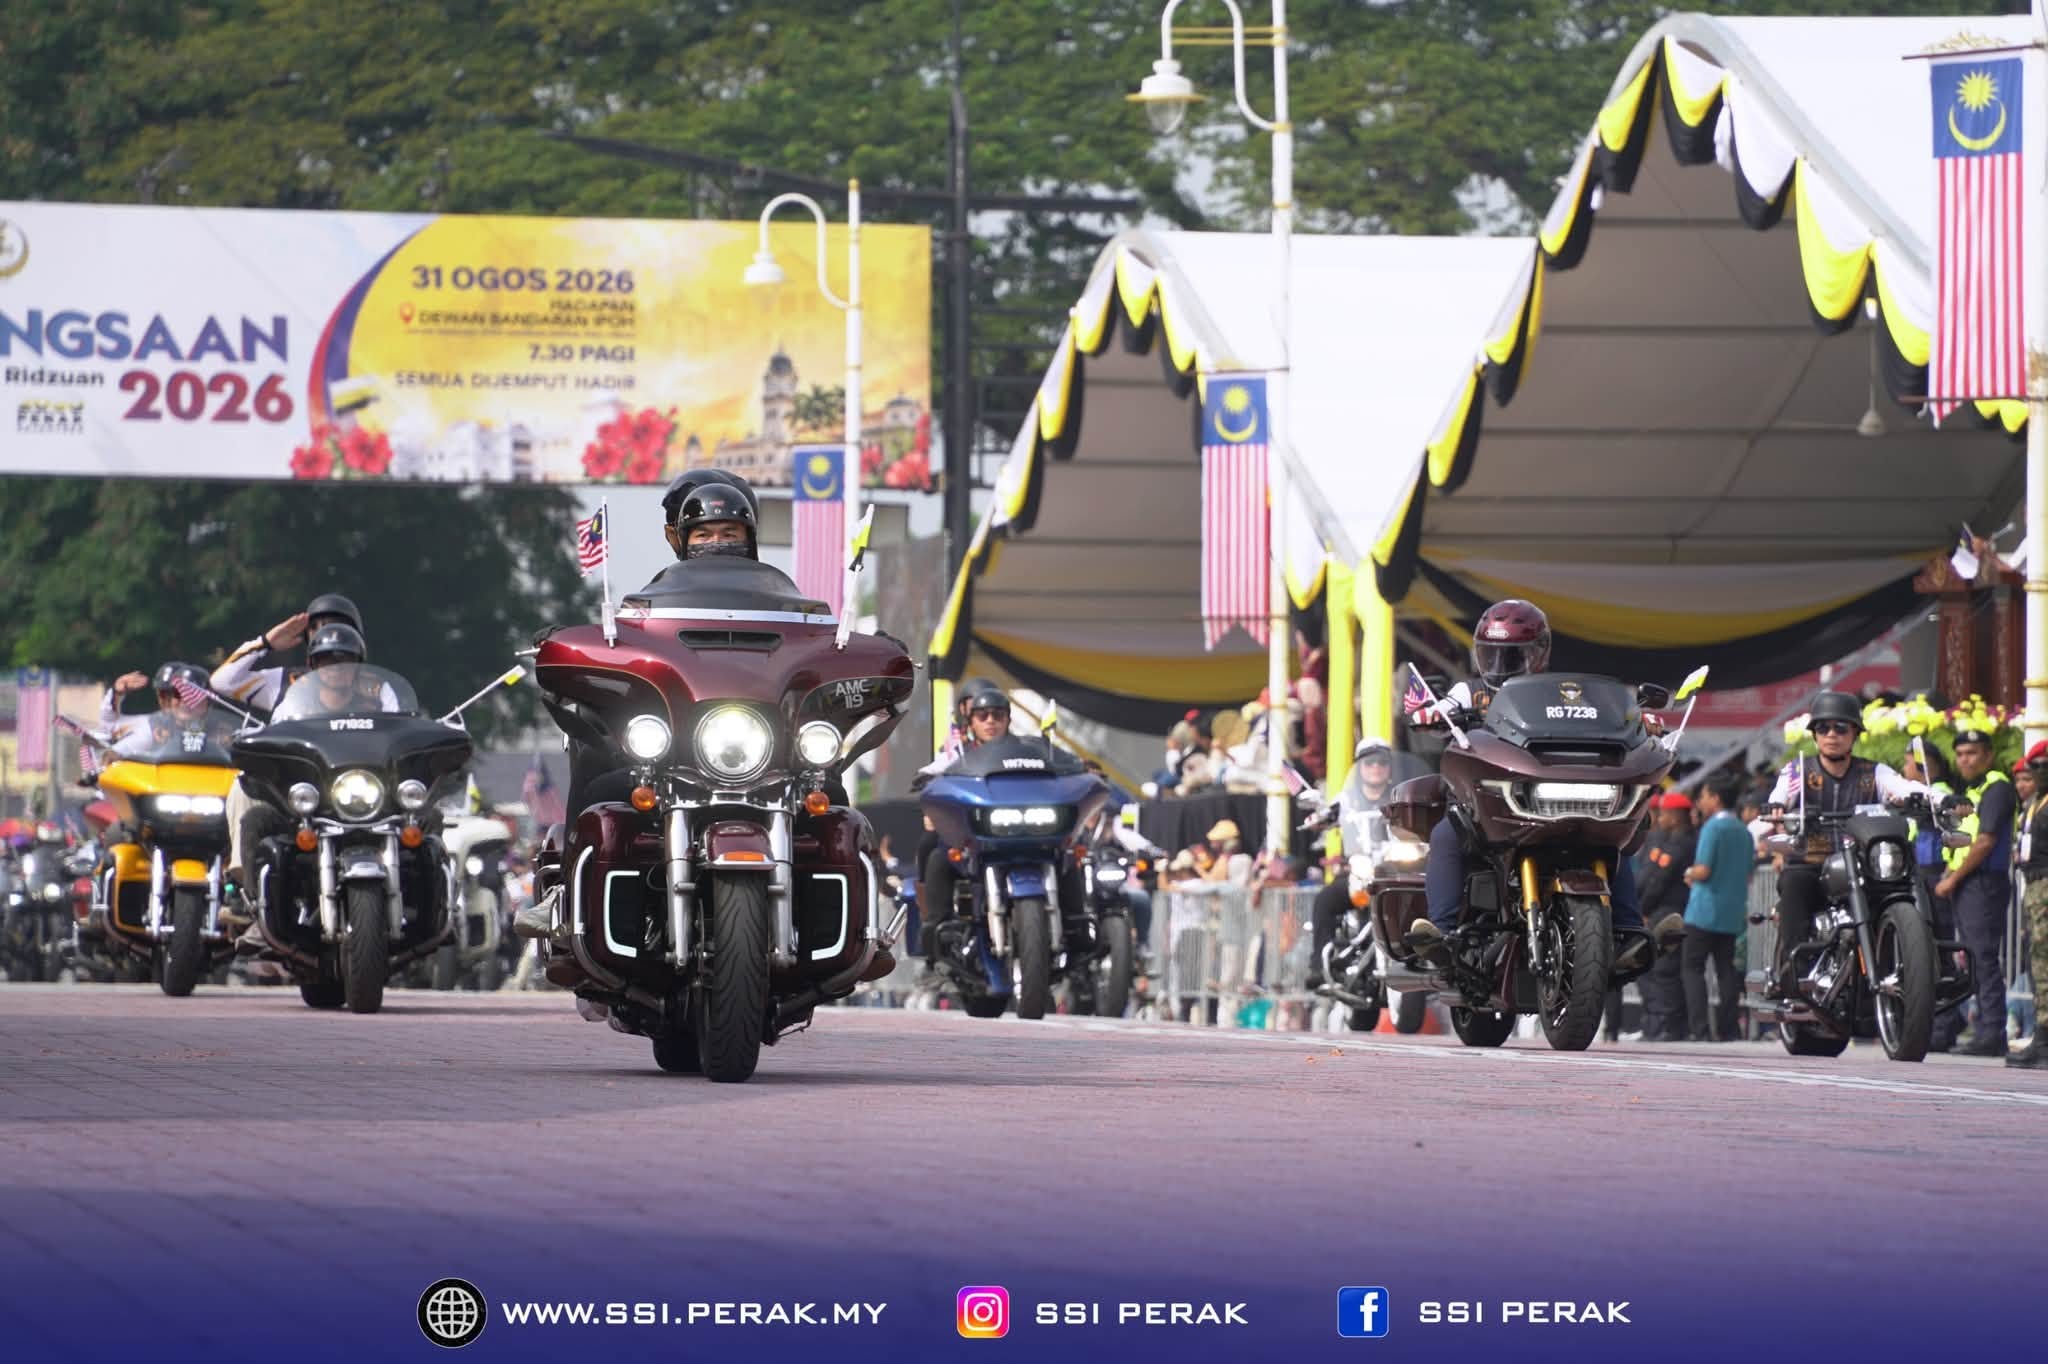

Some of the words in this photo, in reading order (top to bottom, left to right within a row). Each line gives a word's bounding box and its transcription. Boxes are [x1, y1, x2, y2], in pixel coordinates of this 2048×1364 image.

[412, 266, 443, 289] 31
[452, 266, 547, 291] OGOS
[555, 269, 635, 292] 2026
[0, 308, 288, 362] NGSAAN
[529, 344, 573, 361] 7.30
[581, 345, 635, 362] PAGI
[5, 366, 104, 385] Ridzuan
[395, 371, 464, 387] SEMUA
[575, 375, 635, 389] HADIR
[119, 370, 293, 423] 2026
[835, 679, 870, 696] AMC
